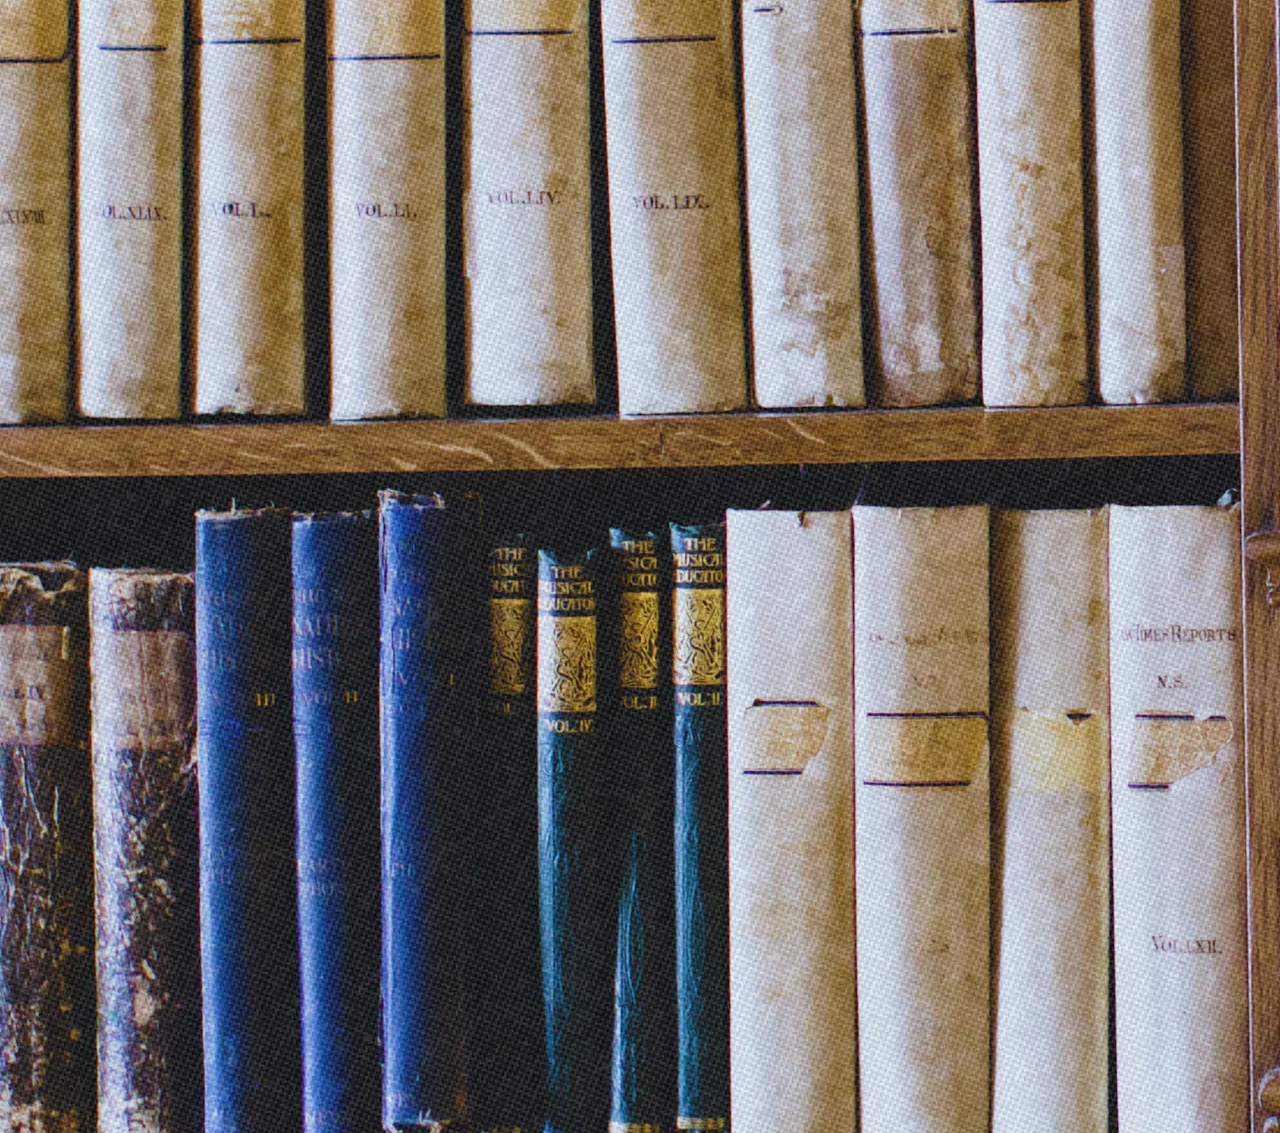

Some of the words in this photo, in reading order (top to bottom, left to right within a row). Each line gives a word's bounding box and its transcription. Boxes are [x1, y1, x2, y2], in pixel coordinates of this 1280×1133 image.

[621, 540, 655, 554] THE
[684, 538, 717, 551] THE
[552, 566, 585, 579] THE
[1171, 625, 1236, 643] REPORTS
[1157, 675, 1188, 689] N.S.
